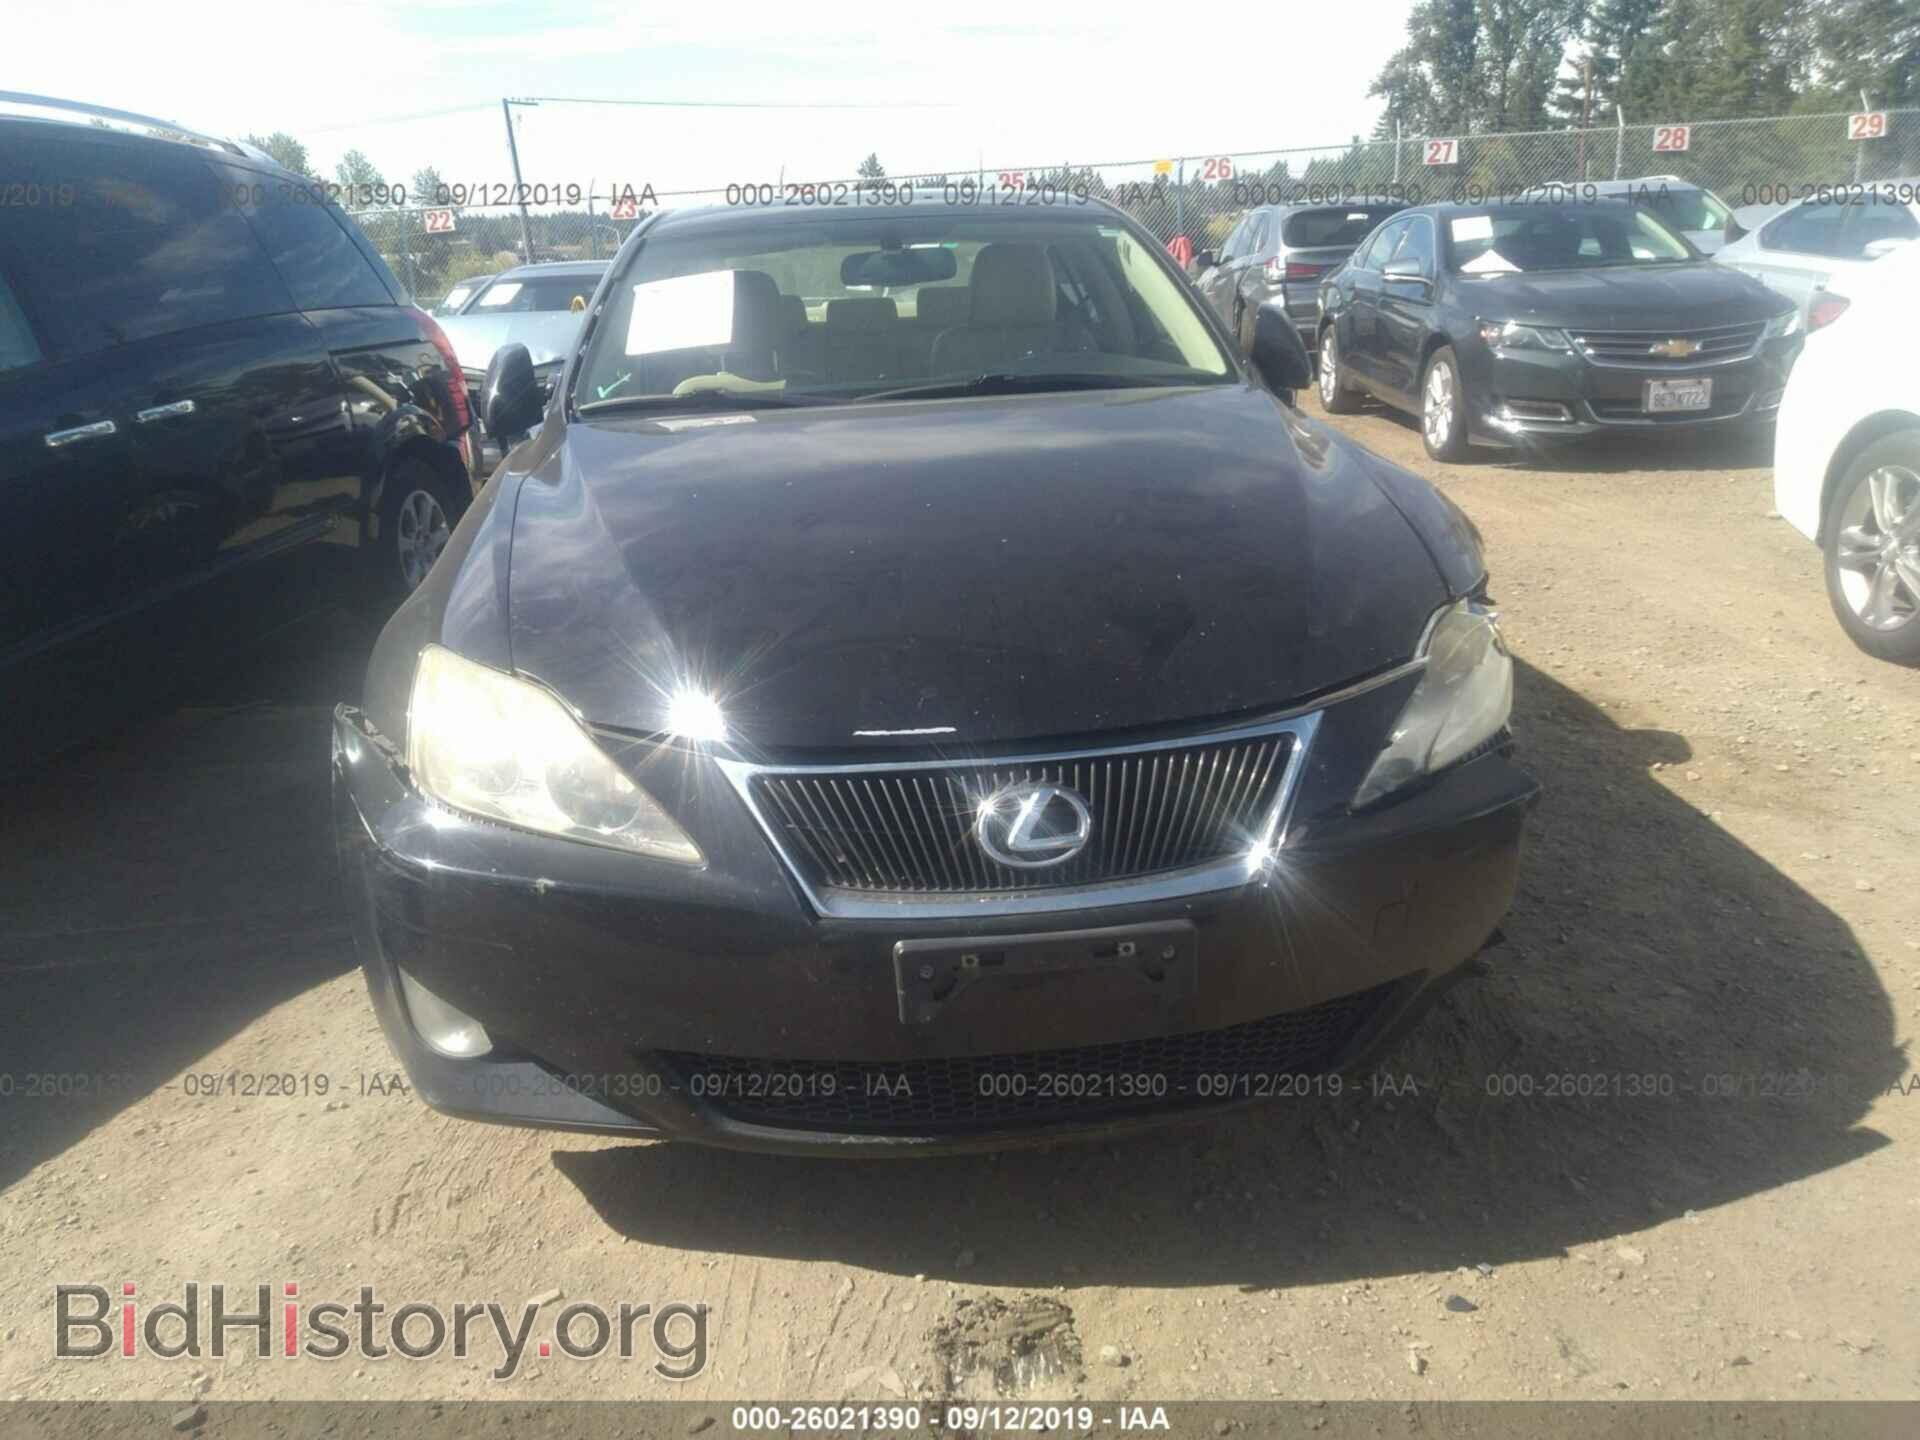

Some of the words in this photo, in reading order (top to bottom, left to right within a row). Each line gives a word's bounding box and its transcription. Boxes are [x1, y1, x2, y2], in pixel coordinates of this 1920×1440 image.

[1854, 114, 1883, 137] 29
[1657, 128, 1686, 150] 28
[1427, 141, 1453, 164] 27
[1203, 158, 1232, 180] 26
[612, 200, 637, 218] 23
[426, 211, 451, 231] 22
